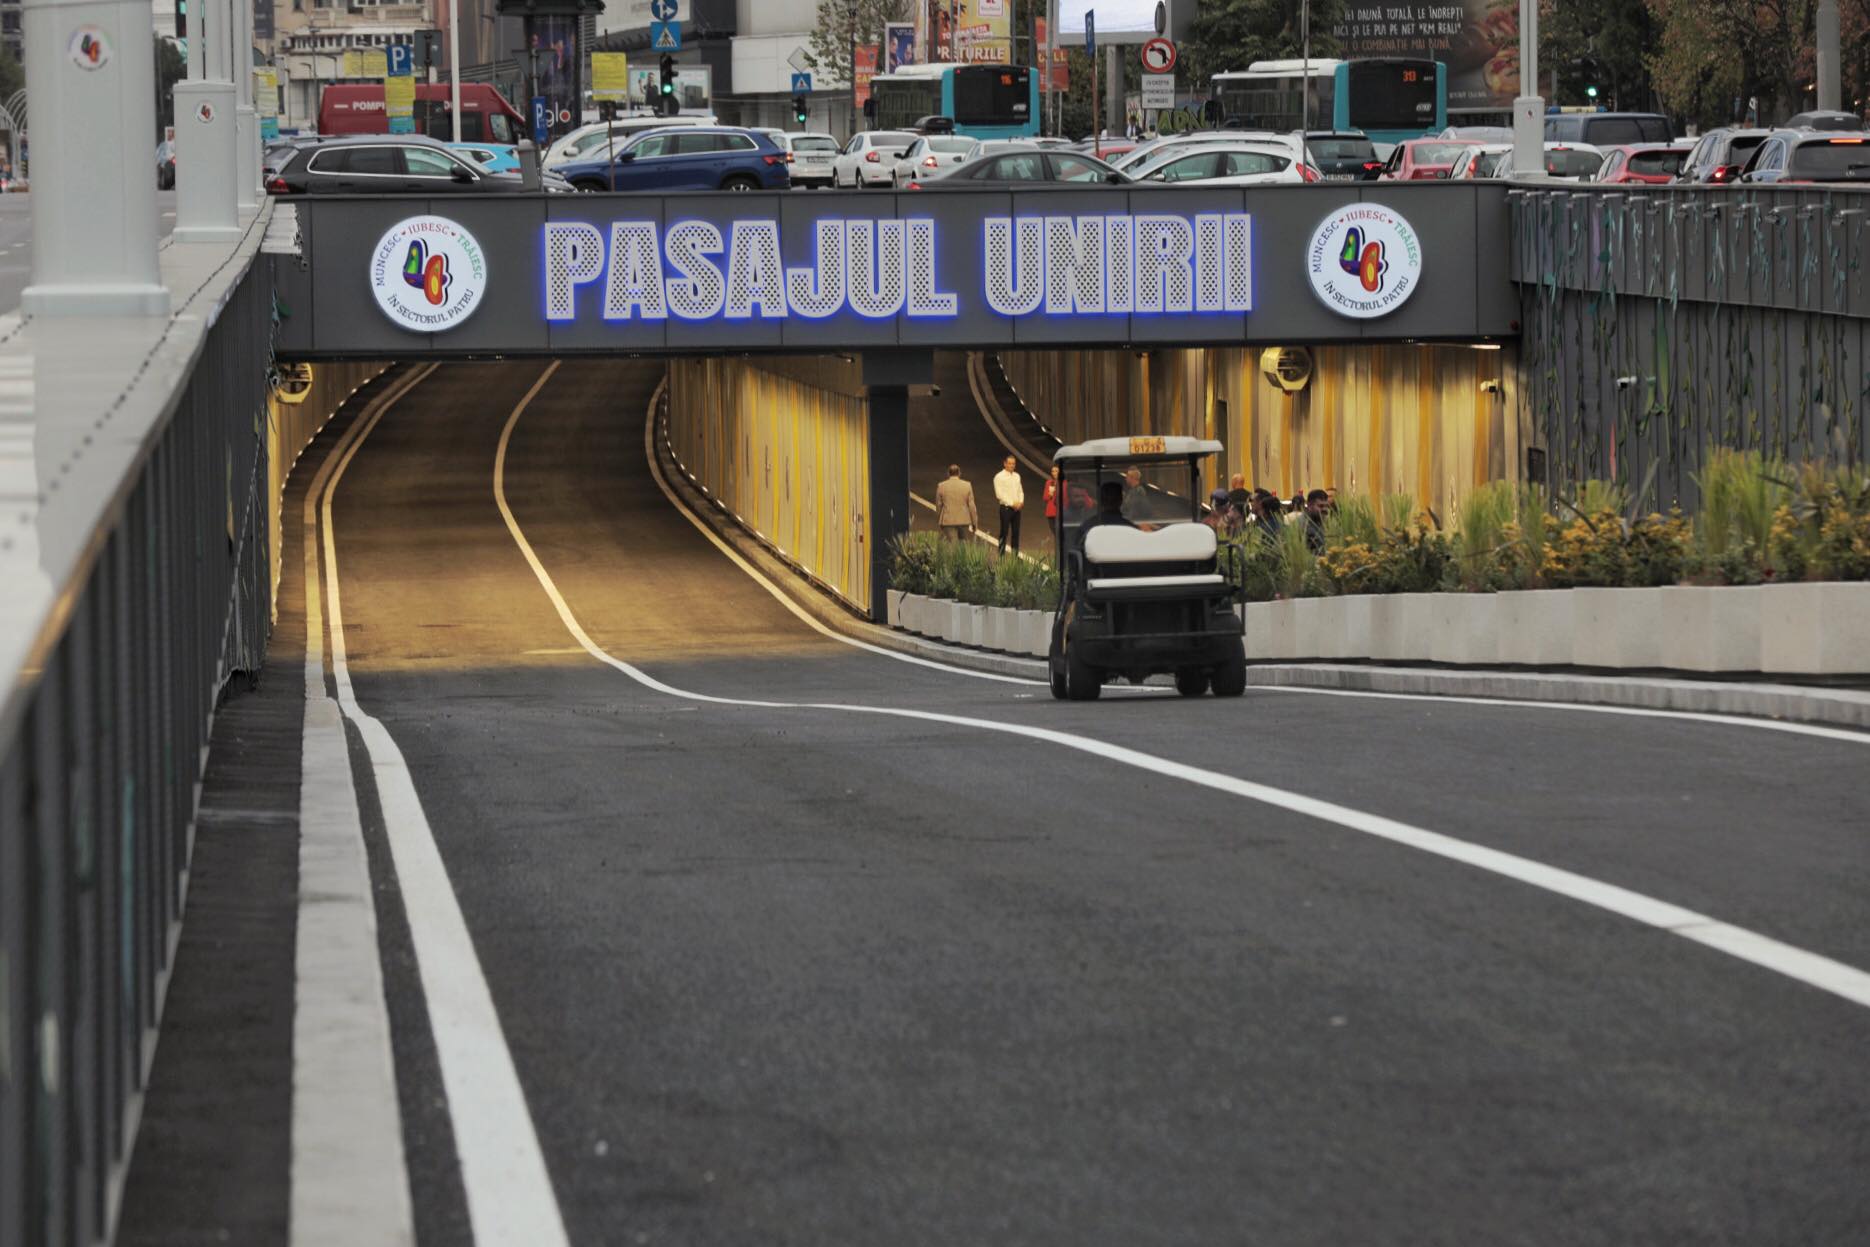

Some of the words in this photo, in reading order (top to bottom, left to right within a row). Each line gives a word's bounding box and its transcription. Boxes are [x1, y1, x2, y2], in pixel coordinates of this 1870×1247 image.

[1418, 8, 1426, 20] LE
[1362, 24, 1370, 36] LE
[1390, 23, 1398, 36] PE
[1401, 22, 1415, 35] NET
[1411, 38, 1425, 49] MAI
[392, 47, 405, 72] P
[352, 101, 385, 111] POMPI
[536, 103, 543, 129] P
[1313, 220, 1340, 273] MUNCESC
[1345, 209, 1387, 223] IUBESC
[375, 233, 402, 287] MUNCESC
[407, 222, 451, 236] IUBESC
[544, 218, 958, 320] PASAJUL
[984, 214, 1252, 315] UNIRII
[396, 305, 449, 324] SECTORUL
[447, 288, 475, 319] PATRU
[1323, 279, 1336, 294] ÎN
[1332, 291, 1383, 311] SECTORUL
[1382, 275, 1409, 305] PATRU
